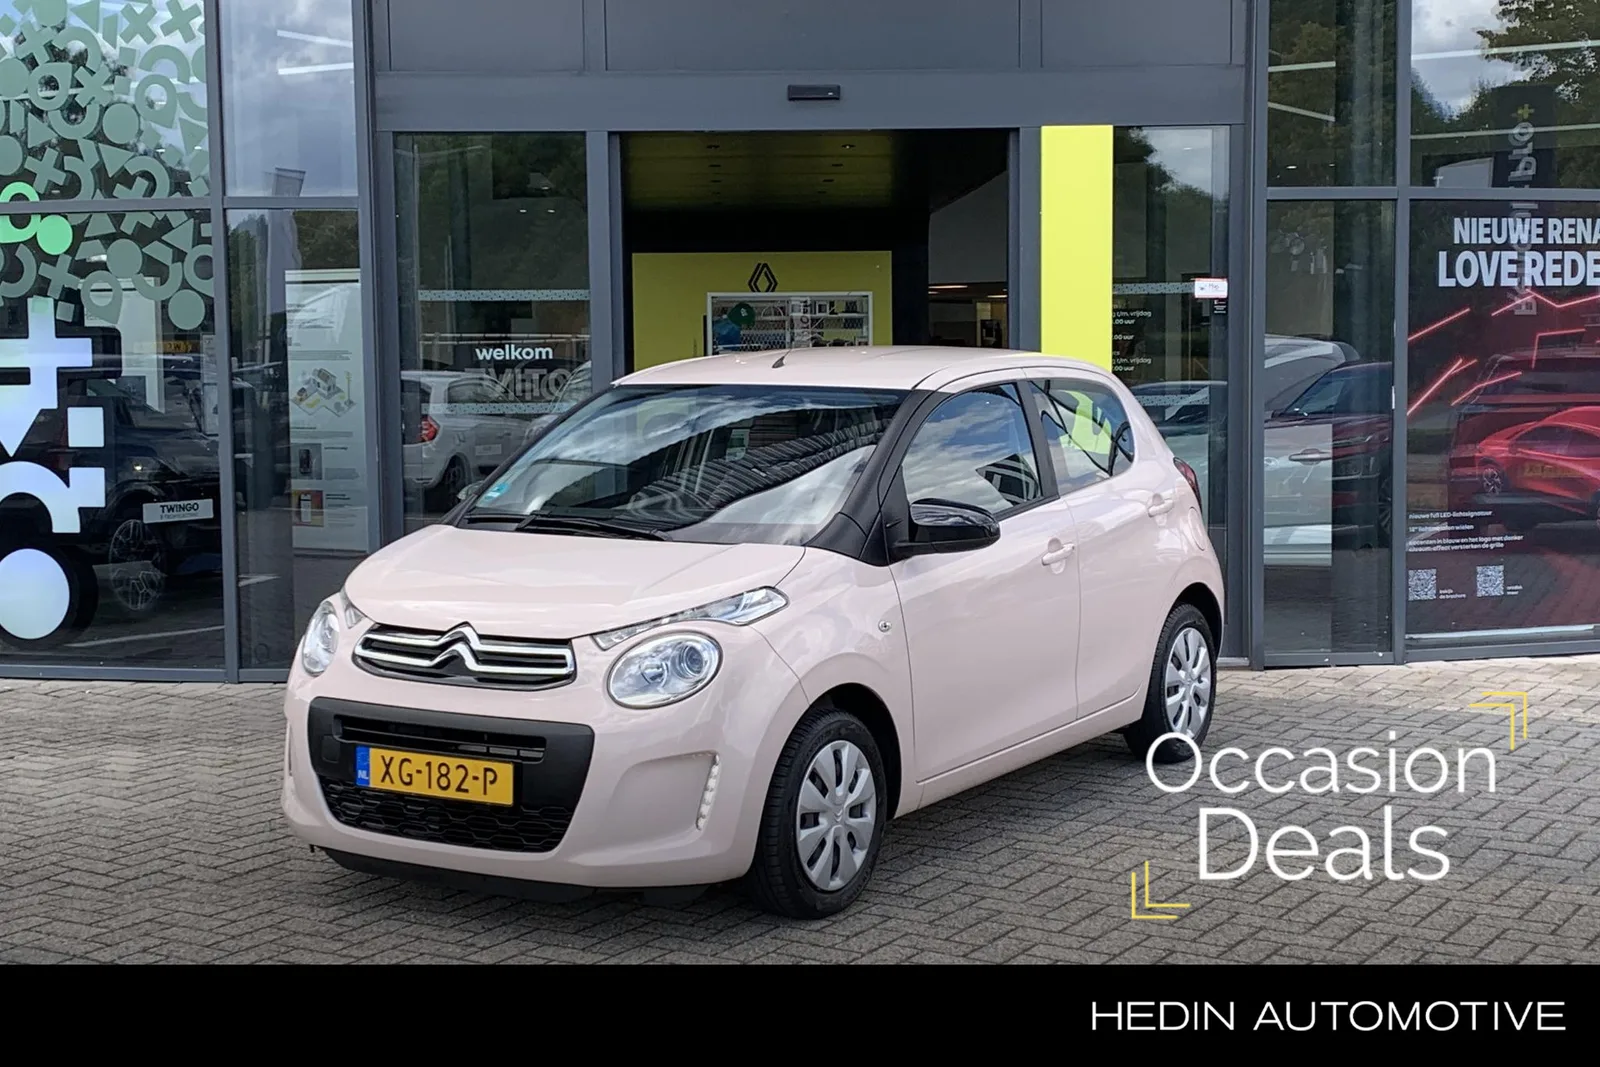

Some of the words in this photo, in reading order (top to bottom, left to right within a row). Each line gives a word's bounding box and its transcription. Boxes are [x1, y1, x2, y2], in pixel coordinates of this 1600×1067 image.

[1453, 217, 1544, 245] NIEUWE
[1438, 250, 1518, 288] LOVE
[475, 343, 553, 360] welkom
[159, 502, 200, 514] TWINGO
[358, 770, 369, 780] NL
[380, 754, 498, 796] XG-182-P
